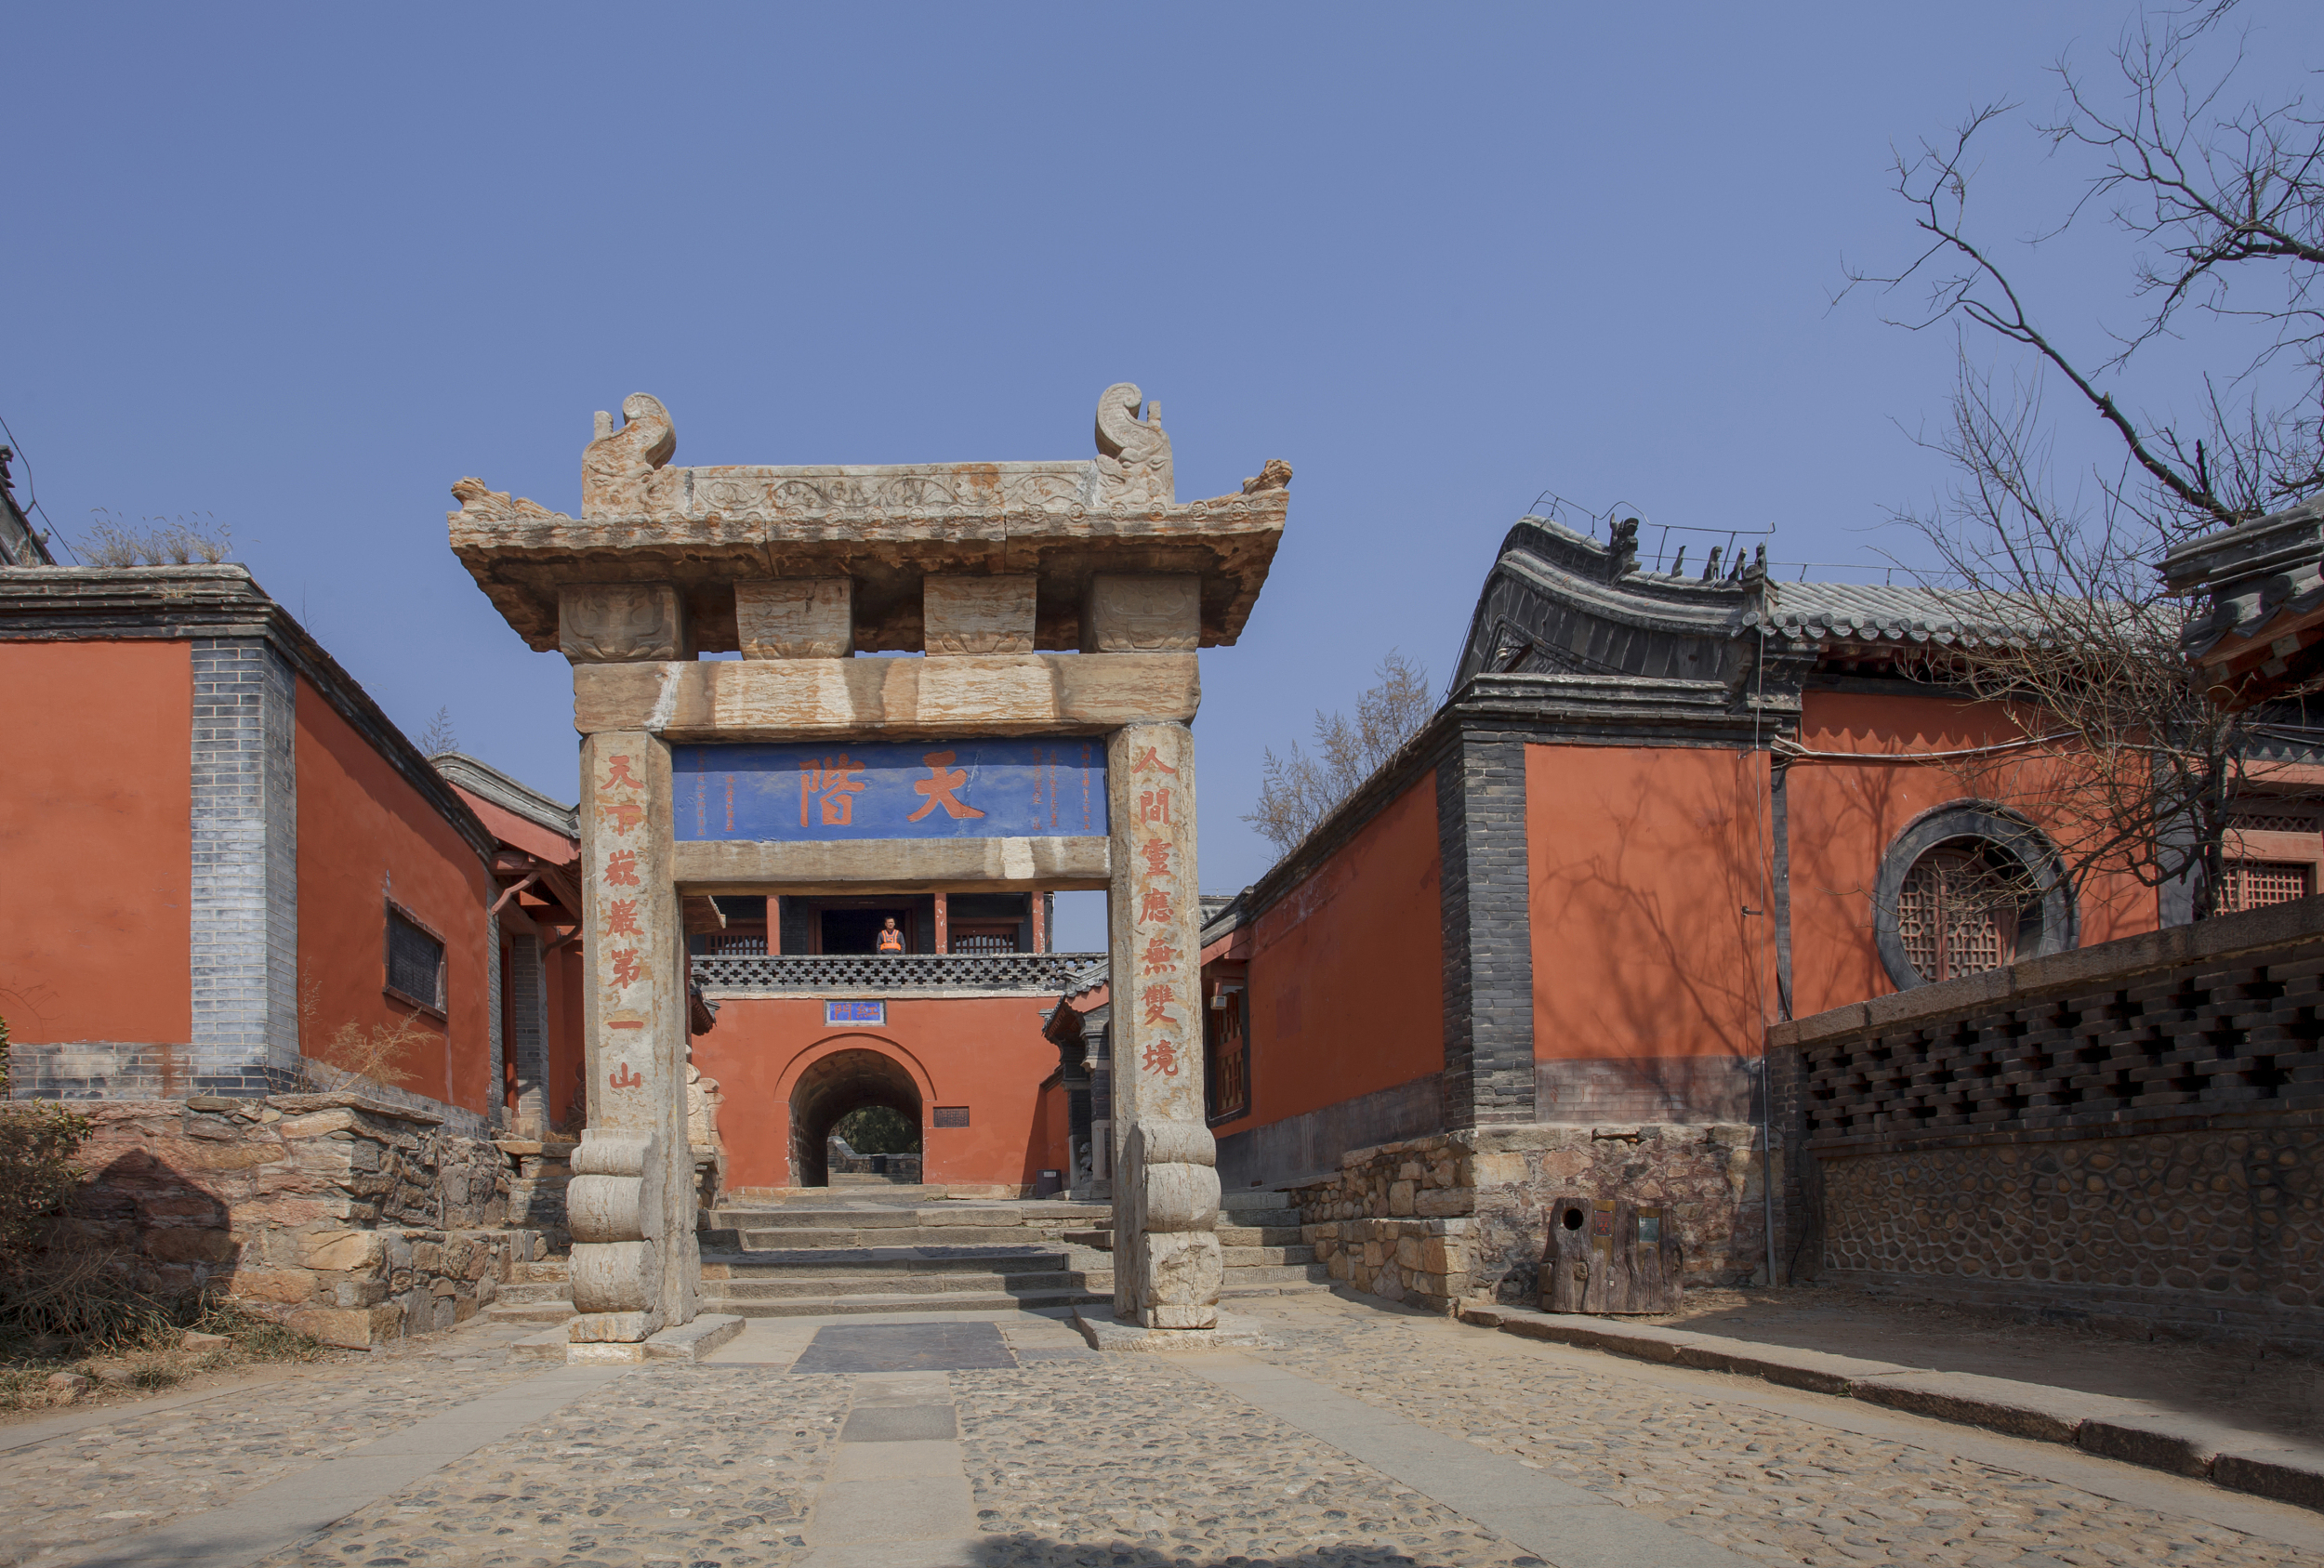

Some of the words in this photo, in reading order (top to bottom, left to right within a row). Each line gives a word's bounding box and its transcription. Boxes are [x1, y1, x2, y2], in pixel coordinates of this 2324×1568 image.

[798, 749, 986, 828] 天階
[1131, 746, 1179, 1076] 人間靈應無雙境
[834, 1003, 879, 1021] 紅門
